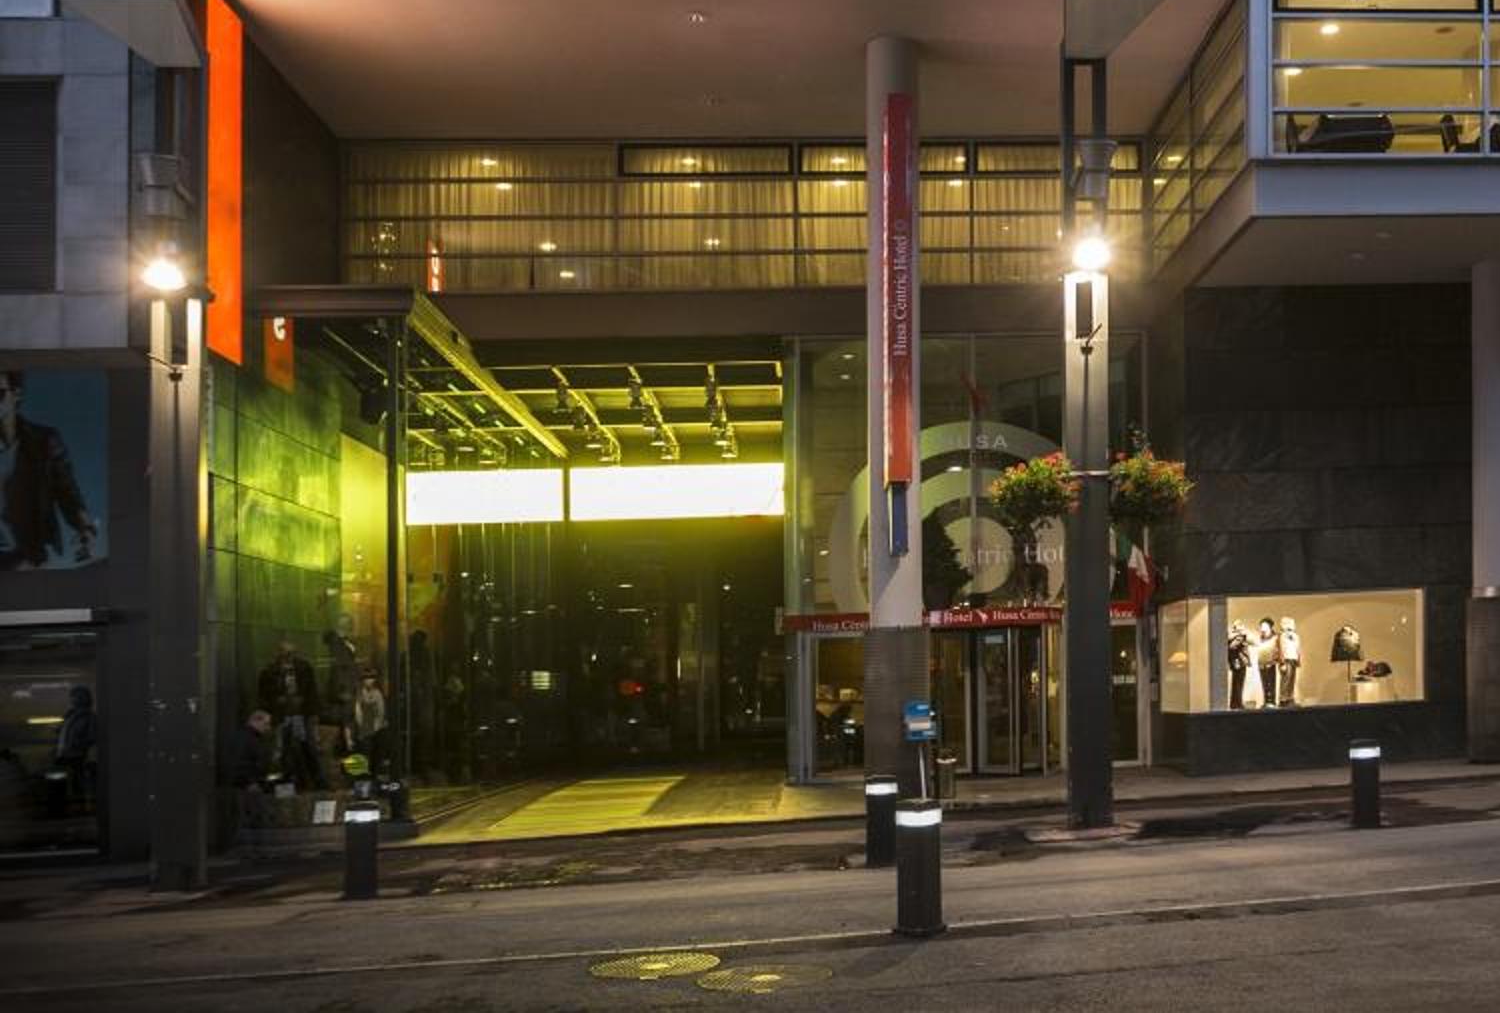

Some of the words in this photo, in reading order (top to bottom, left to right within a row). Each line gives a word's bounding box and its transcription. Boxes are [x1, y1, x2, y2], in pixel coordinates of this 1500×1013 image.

[893, 235, 907, 271] Hotel
[893, 273, 907, 320] Centric
[893, 322, 908, 356] Husa
[943, 610, 973, 624] Hotel
